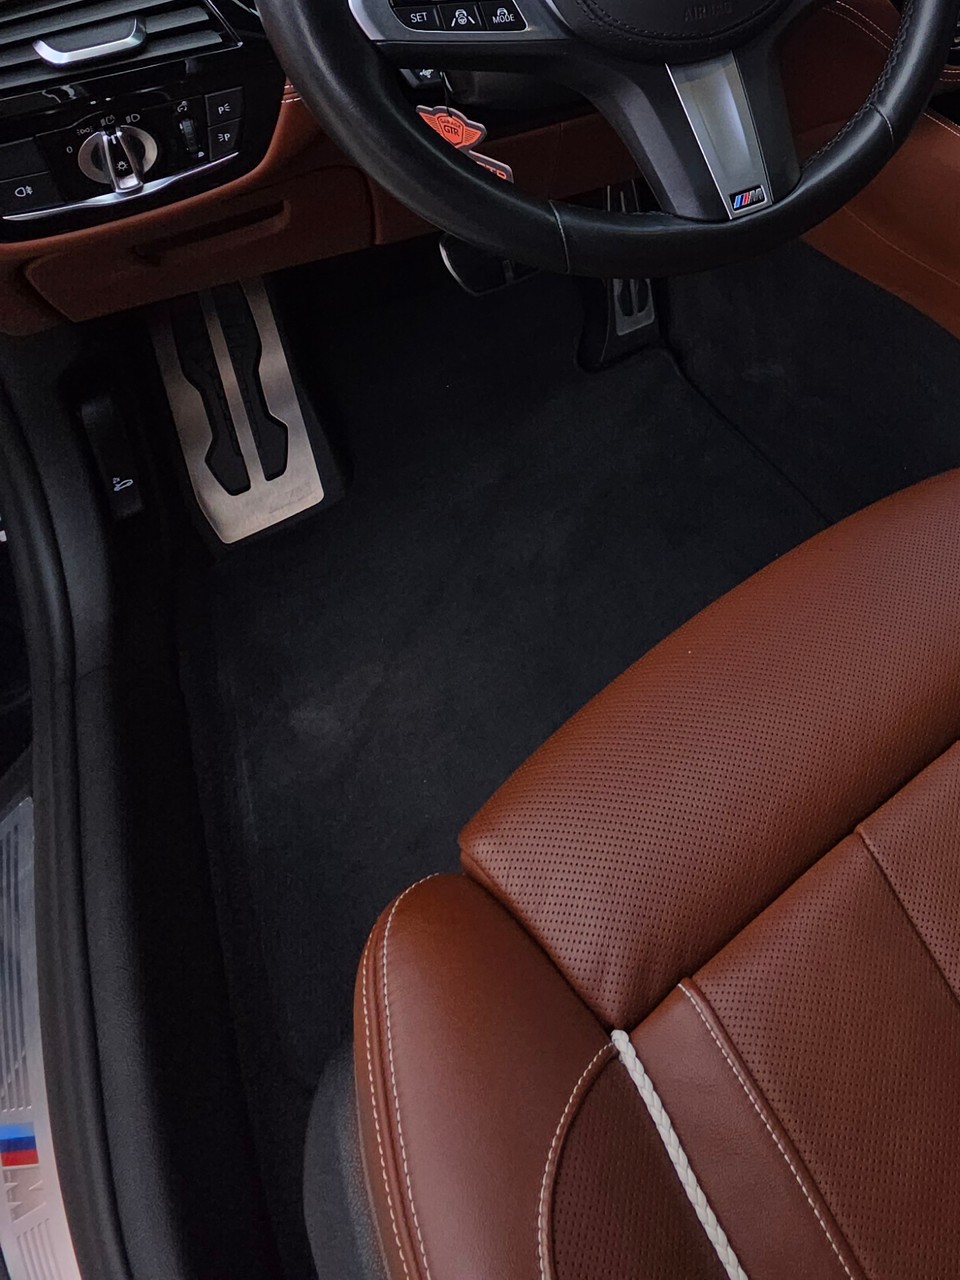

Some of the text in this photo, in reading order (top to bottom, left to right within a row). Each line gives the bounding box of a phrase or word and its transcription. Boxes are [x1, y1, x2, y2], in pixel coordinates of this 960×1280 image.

[410, 12, 428, 23] SET
[492, 14, 515, 24] MODE
[443, 124, 460, 137] GTR
